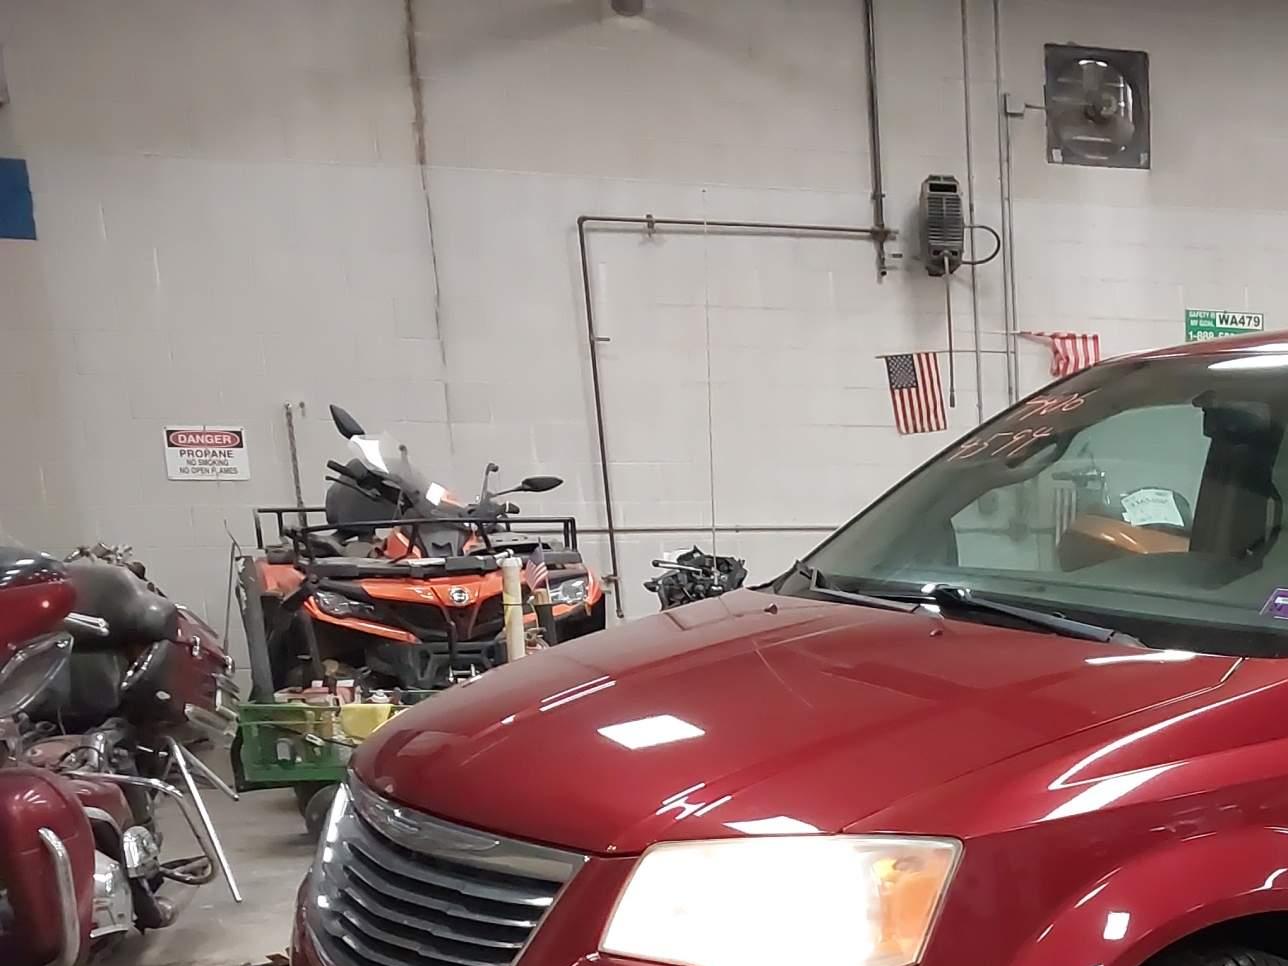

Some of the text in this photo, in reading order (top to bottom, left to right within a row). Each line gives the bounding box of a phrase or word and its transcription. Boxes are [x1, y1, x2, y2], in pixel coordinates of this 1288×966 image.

[1218, 314, 1261, 327] WA479
[177, 434, 232, 444] DANGER
[179, 449, 233, 458] PROPANE
